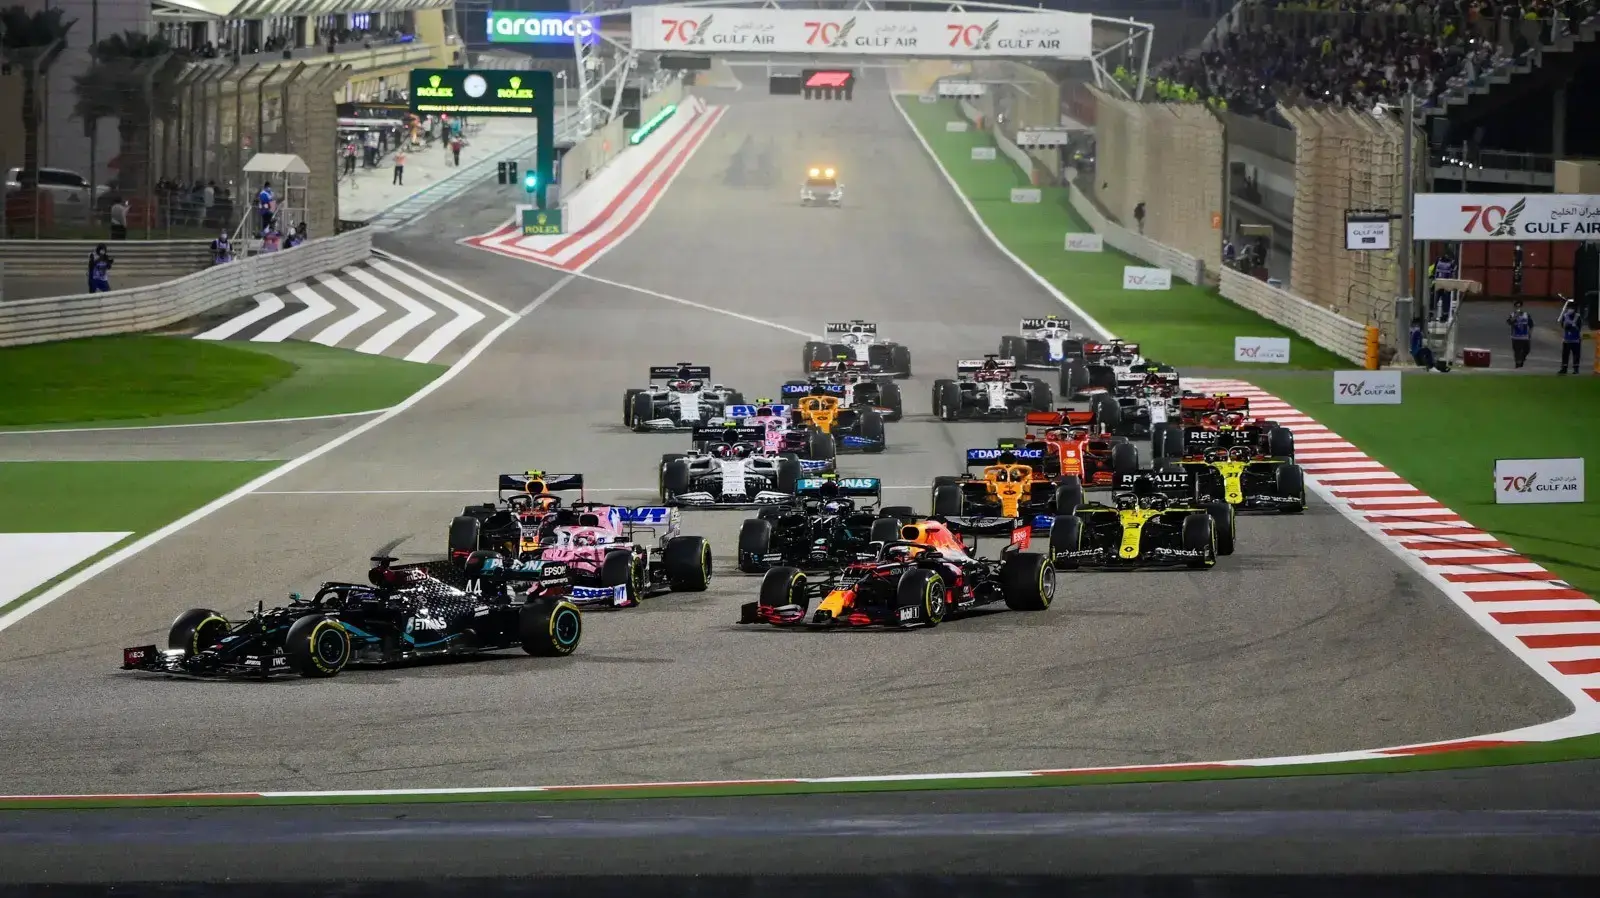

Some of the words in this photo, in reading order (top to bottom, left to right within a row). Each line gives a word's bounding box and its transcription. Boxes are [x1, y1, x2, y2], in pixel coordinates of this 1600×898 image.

[713, 34, 749, 44] GULF
[752, 34, 775, 44] AIR
[855, 37, 891, 47] GULF
[895, 37, 917, 47] AIR
[998, 39, 1033, 49] GULF
[1038, 39, 1060, 49] AIR
[1551, 207, 1577, 220] الخليج
[1461, 205, 1507, 234] 70
[1524, 222, 1570, 234] GULF
[1574, 222, 1600, 234] AIR
[1123, 474, 1188, 483] REAULT
[1503, 476, 1527, 492] 70
[1562, 483, 1577, 491] AIR
[544, 565, 567, 576] EPSON
[466, 579, 482, 596] 44
[901, 608, 913, 620] Mobil
[273, 657, 287, 666] IWC
